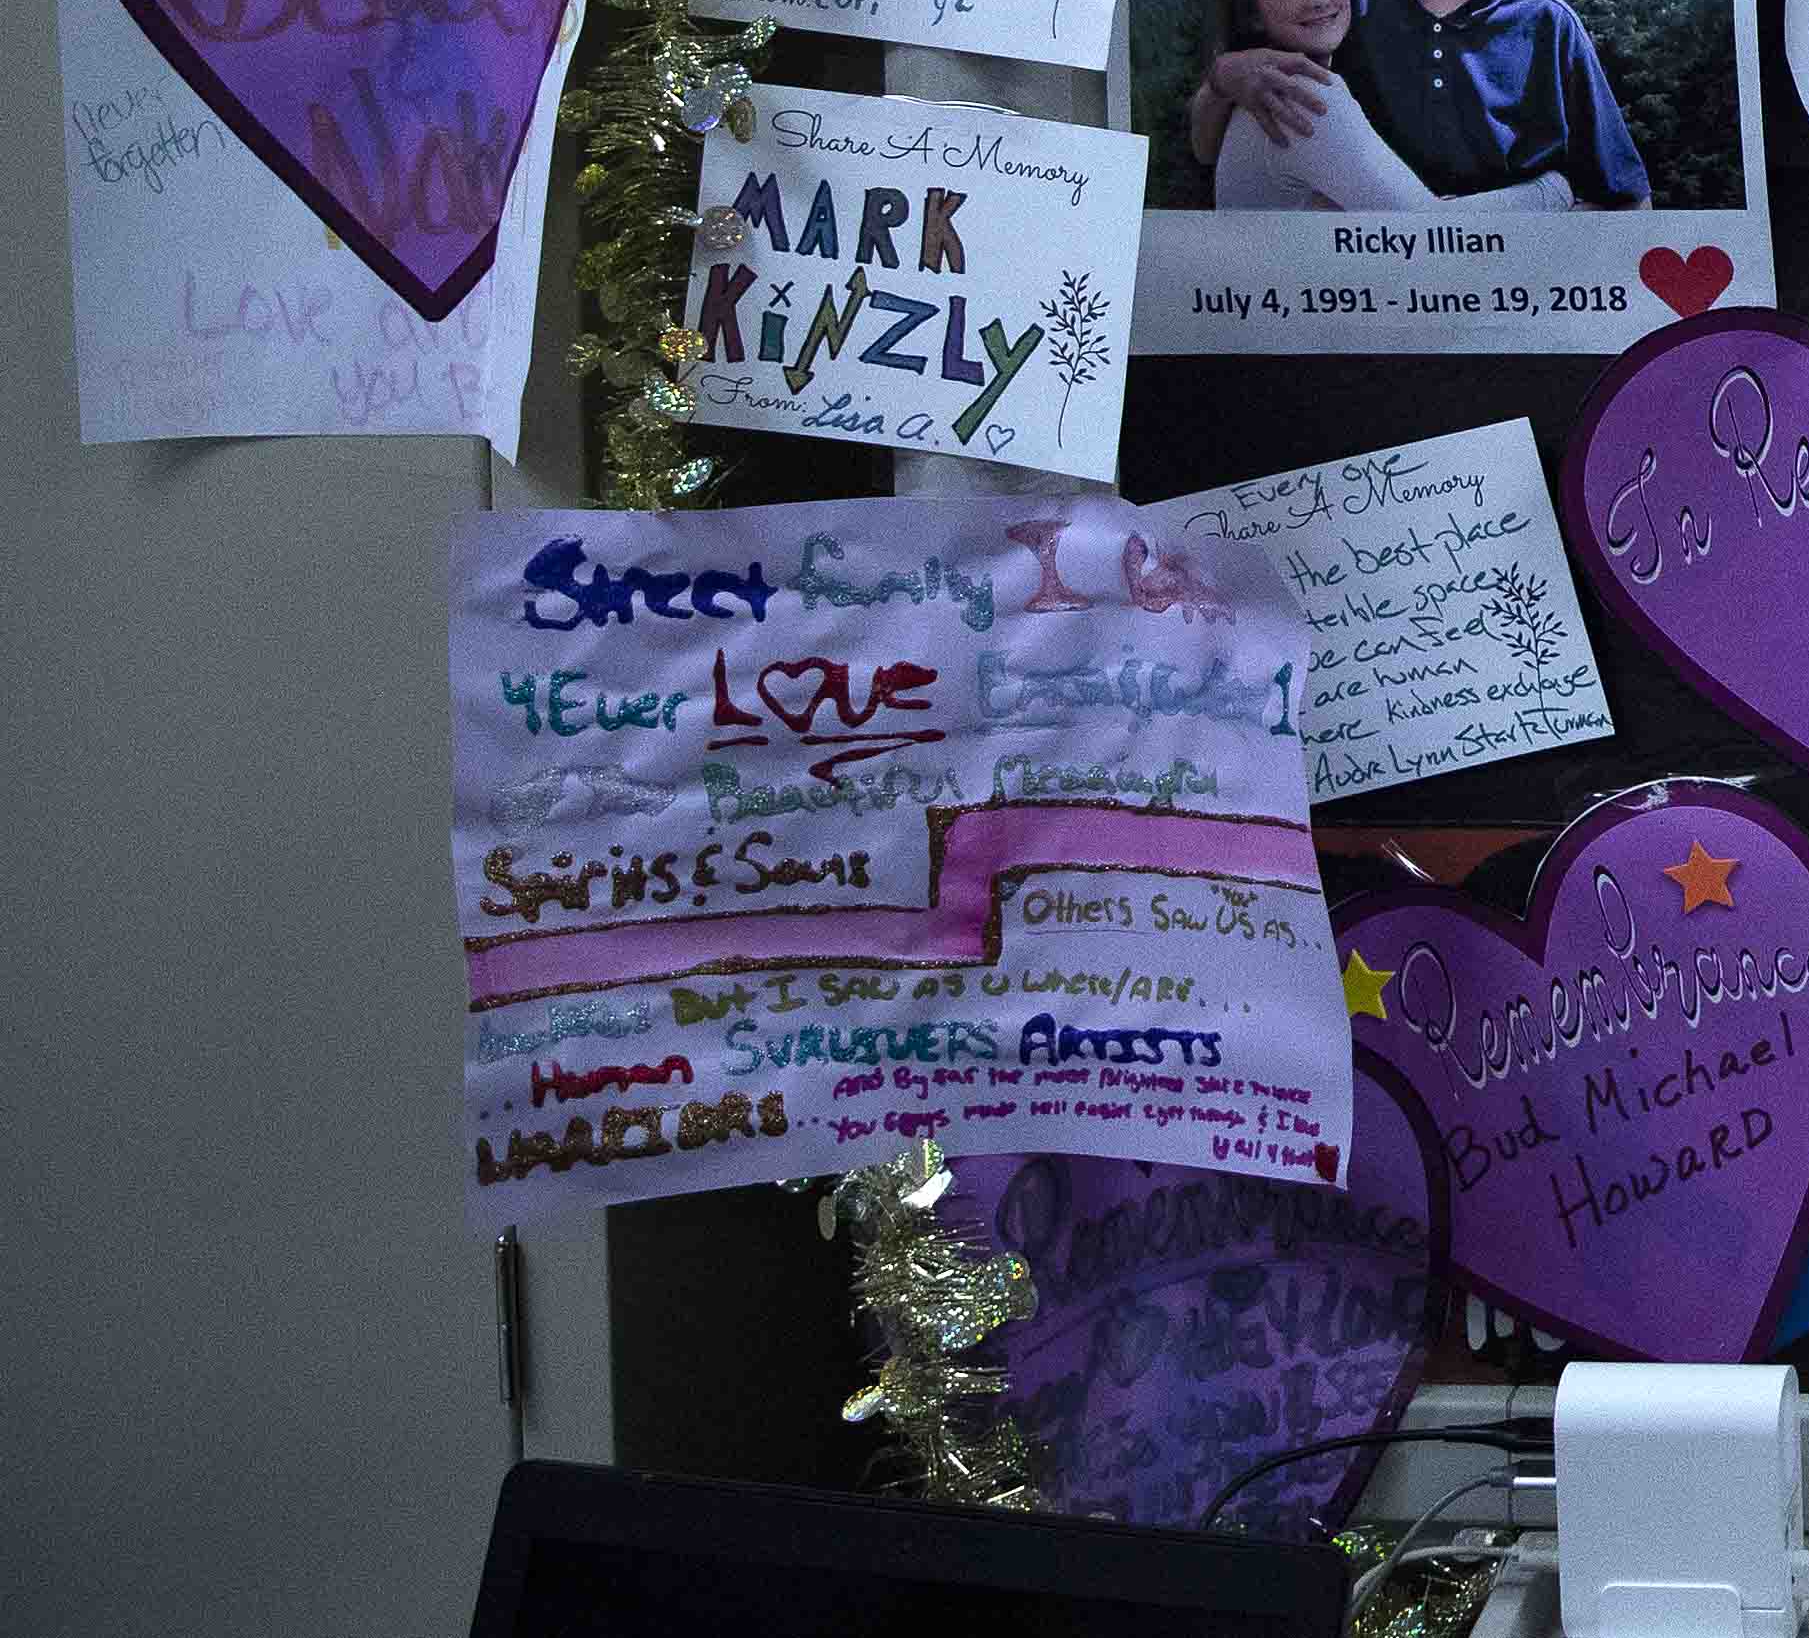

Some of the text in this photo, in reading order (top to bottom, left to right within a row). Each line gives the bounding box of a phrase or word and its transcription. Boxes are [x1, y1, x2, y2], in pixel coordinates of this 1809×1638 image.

[773, 109, 876, 158] Share
[942, 135, 1089, 208] Memory
[733, 170, 968, 274] MARK
[1334, 226, 1505, 257] Ricky Illian
[1192, 284, 1628, 319] July 4, 1991 June 19, 2018
[1606, 446, 1713, 585] In
